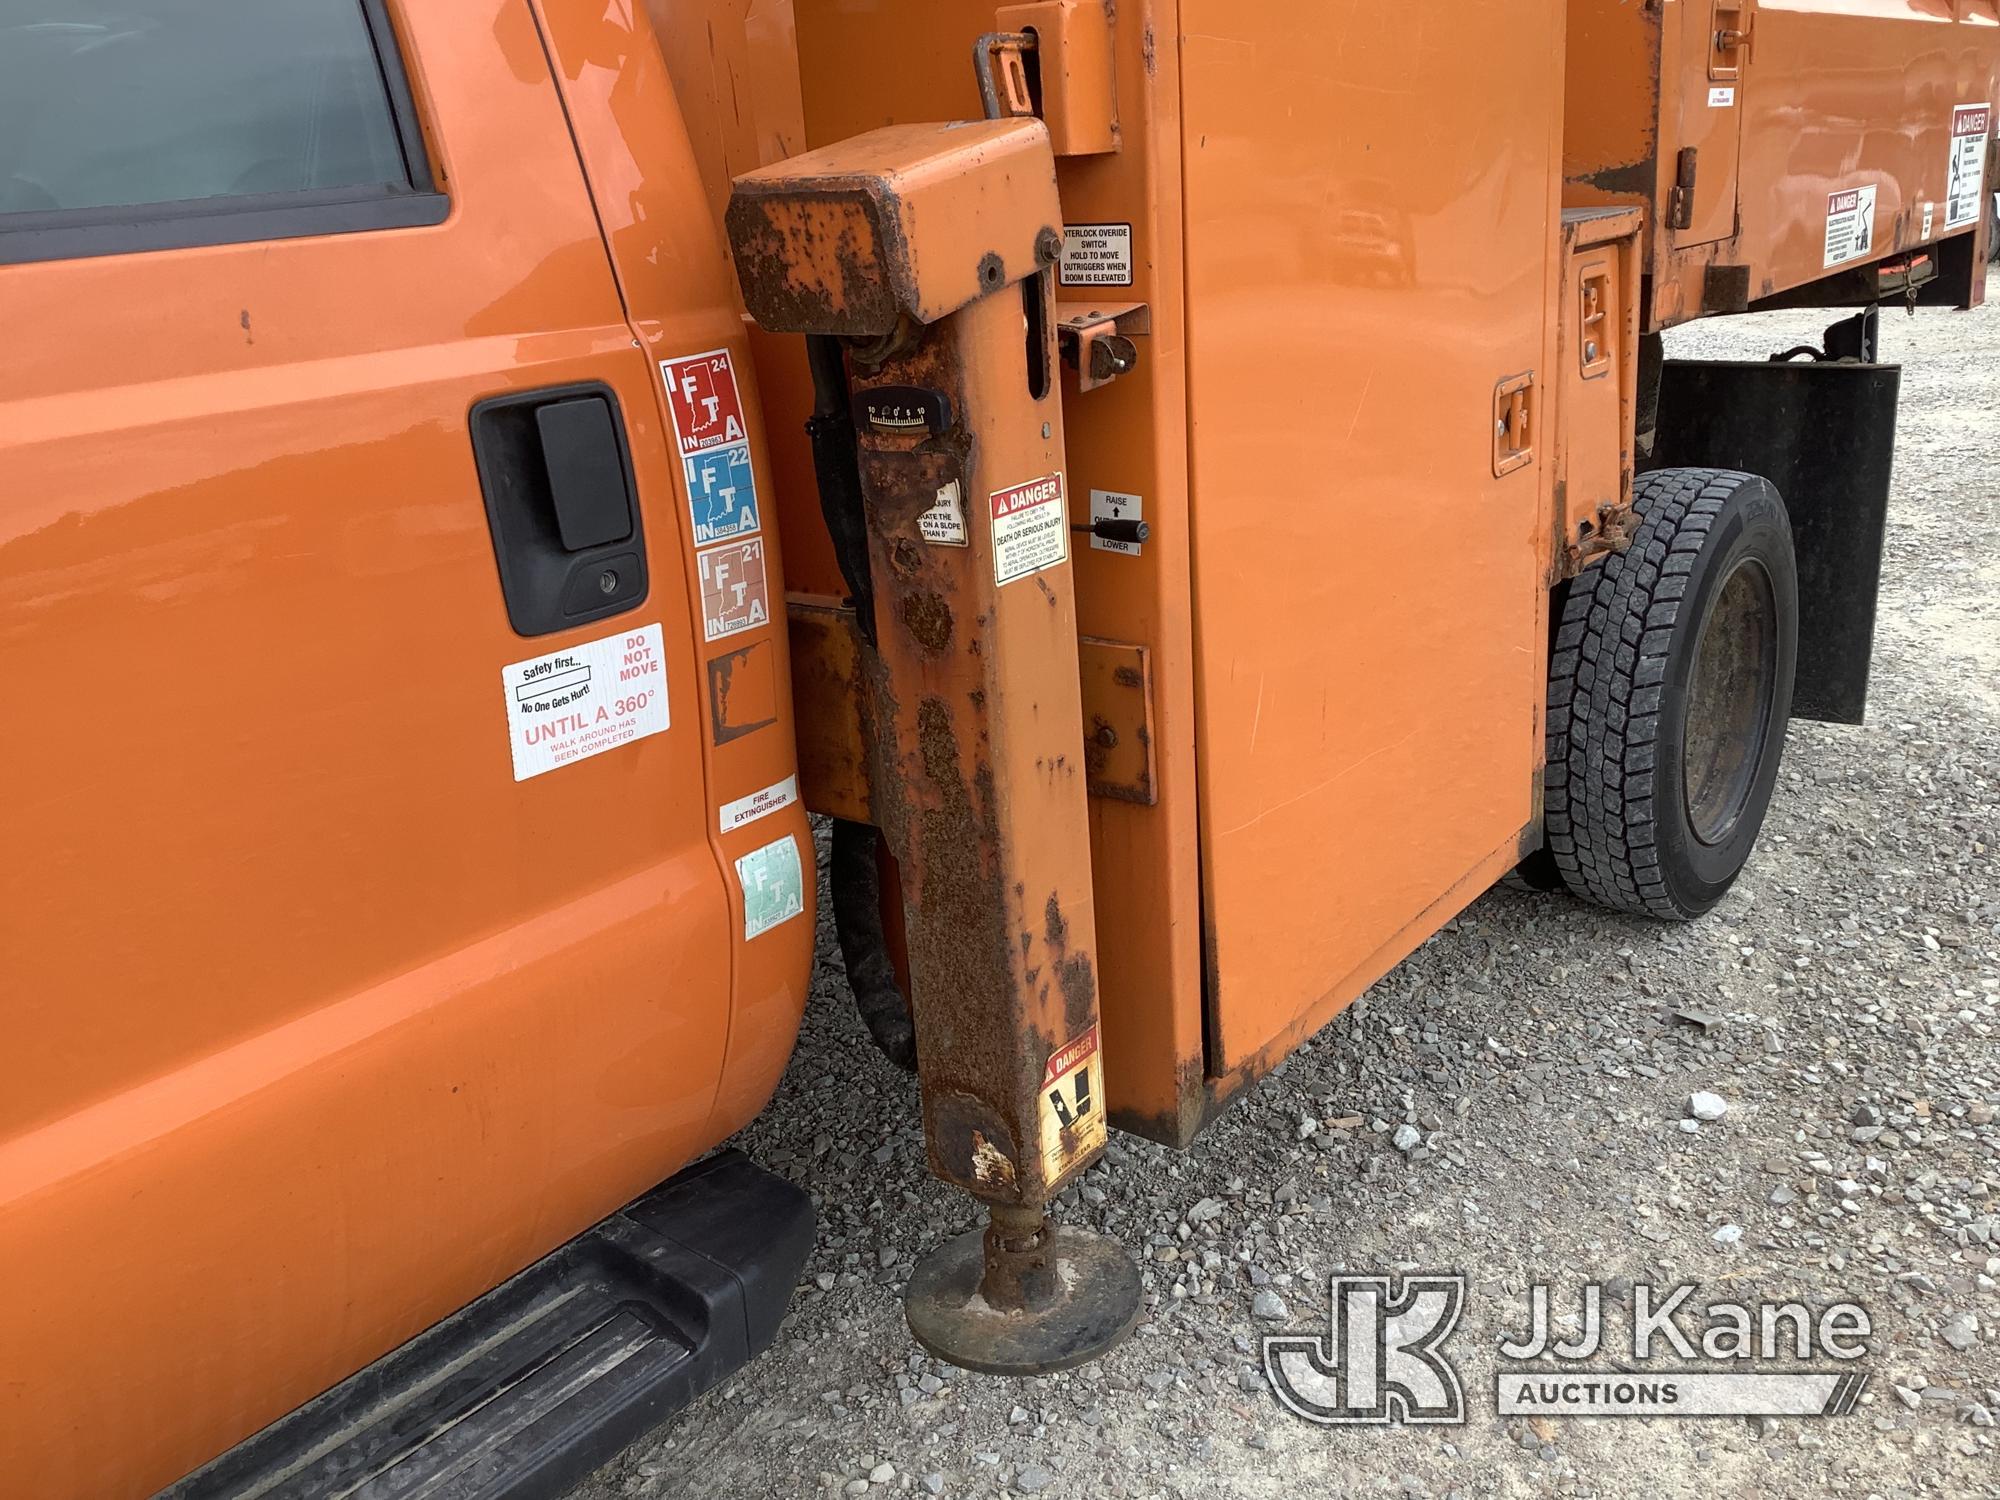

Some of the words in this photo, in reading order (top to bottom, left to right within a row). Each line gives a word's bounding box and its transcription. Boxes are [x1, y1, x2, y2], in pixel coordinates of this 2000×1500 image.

[711, 357, 728, 372] 24
[683, 435, 698, 450] IN
[728, 447, 748, 466] 22
[1011, 481, 1056, 510] DANGER
[1106, 496, 1127, 506] RAISE
[697, 522, 714, 540] IN
[940, 522, 961, 530] SLOPE
[996, 532, 1012, 546] DEATH
[1013, 529, 1021, 540] OR
[1022, 522, 1043, 536] SERIOUS
[1044, 516, 1060, 529] INJURY
[742, 542, 760, 562] 21
[1103, 540, 1128, 551] LOWER
[708, 616, 724, 635] IN
[626, 635, 645, 650] DO
[624, 648, 651, 665] NOT
[523, 662, 552, 680] Safety
[620, 660, 658, 681] MOVE
[522, 703, 532, 713] No
[534, 702, 550, 712] One
[552, 696, 570, 708] Gets
[570, 684, 590, 702] Hurt!
[525, 712, 589, 746] UNTIL
[596, 706, 609, 723] A
[550, 740, 576, 752] WALK
[580, 724, 616, 744] AROUND
[619, 718, 636, 730] HAS
[554, 747, 578, 762] BEEN
[582, 730, 634, 752] COMPLETED
[753, 792, 769, 804] FIRE
[734, 794, 787, 822] EXTINGUISHER
[1056, 1036, 1092, 1073] DANGER
